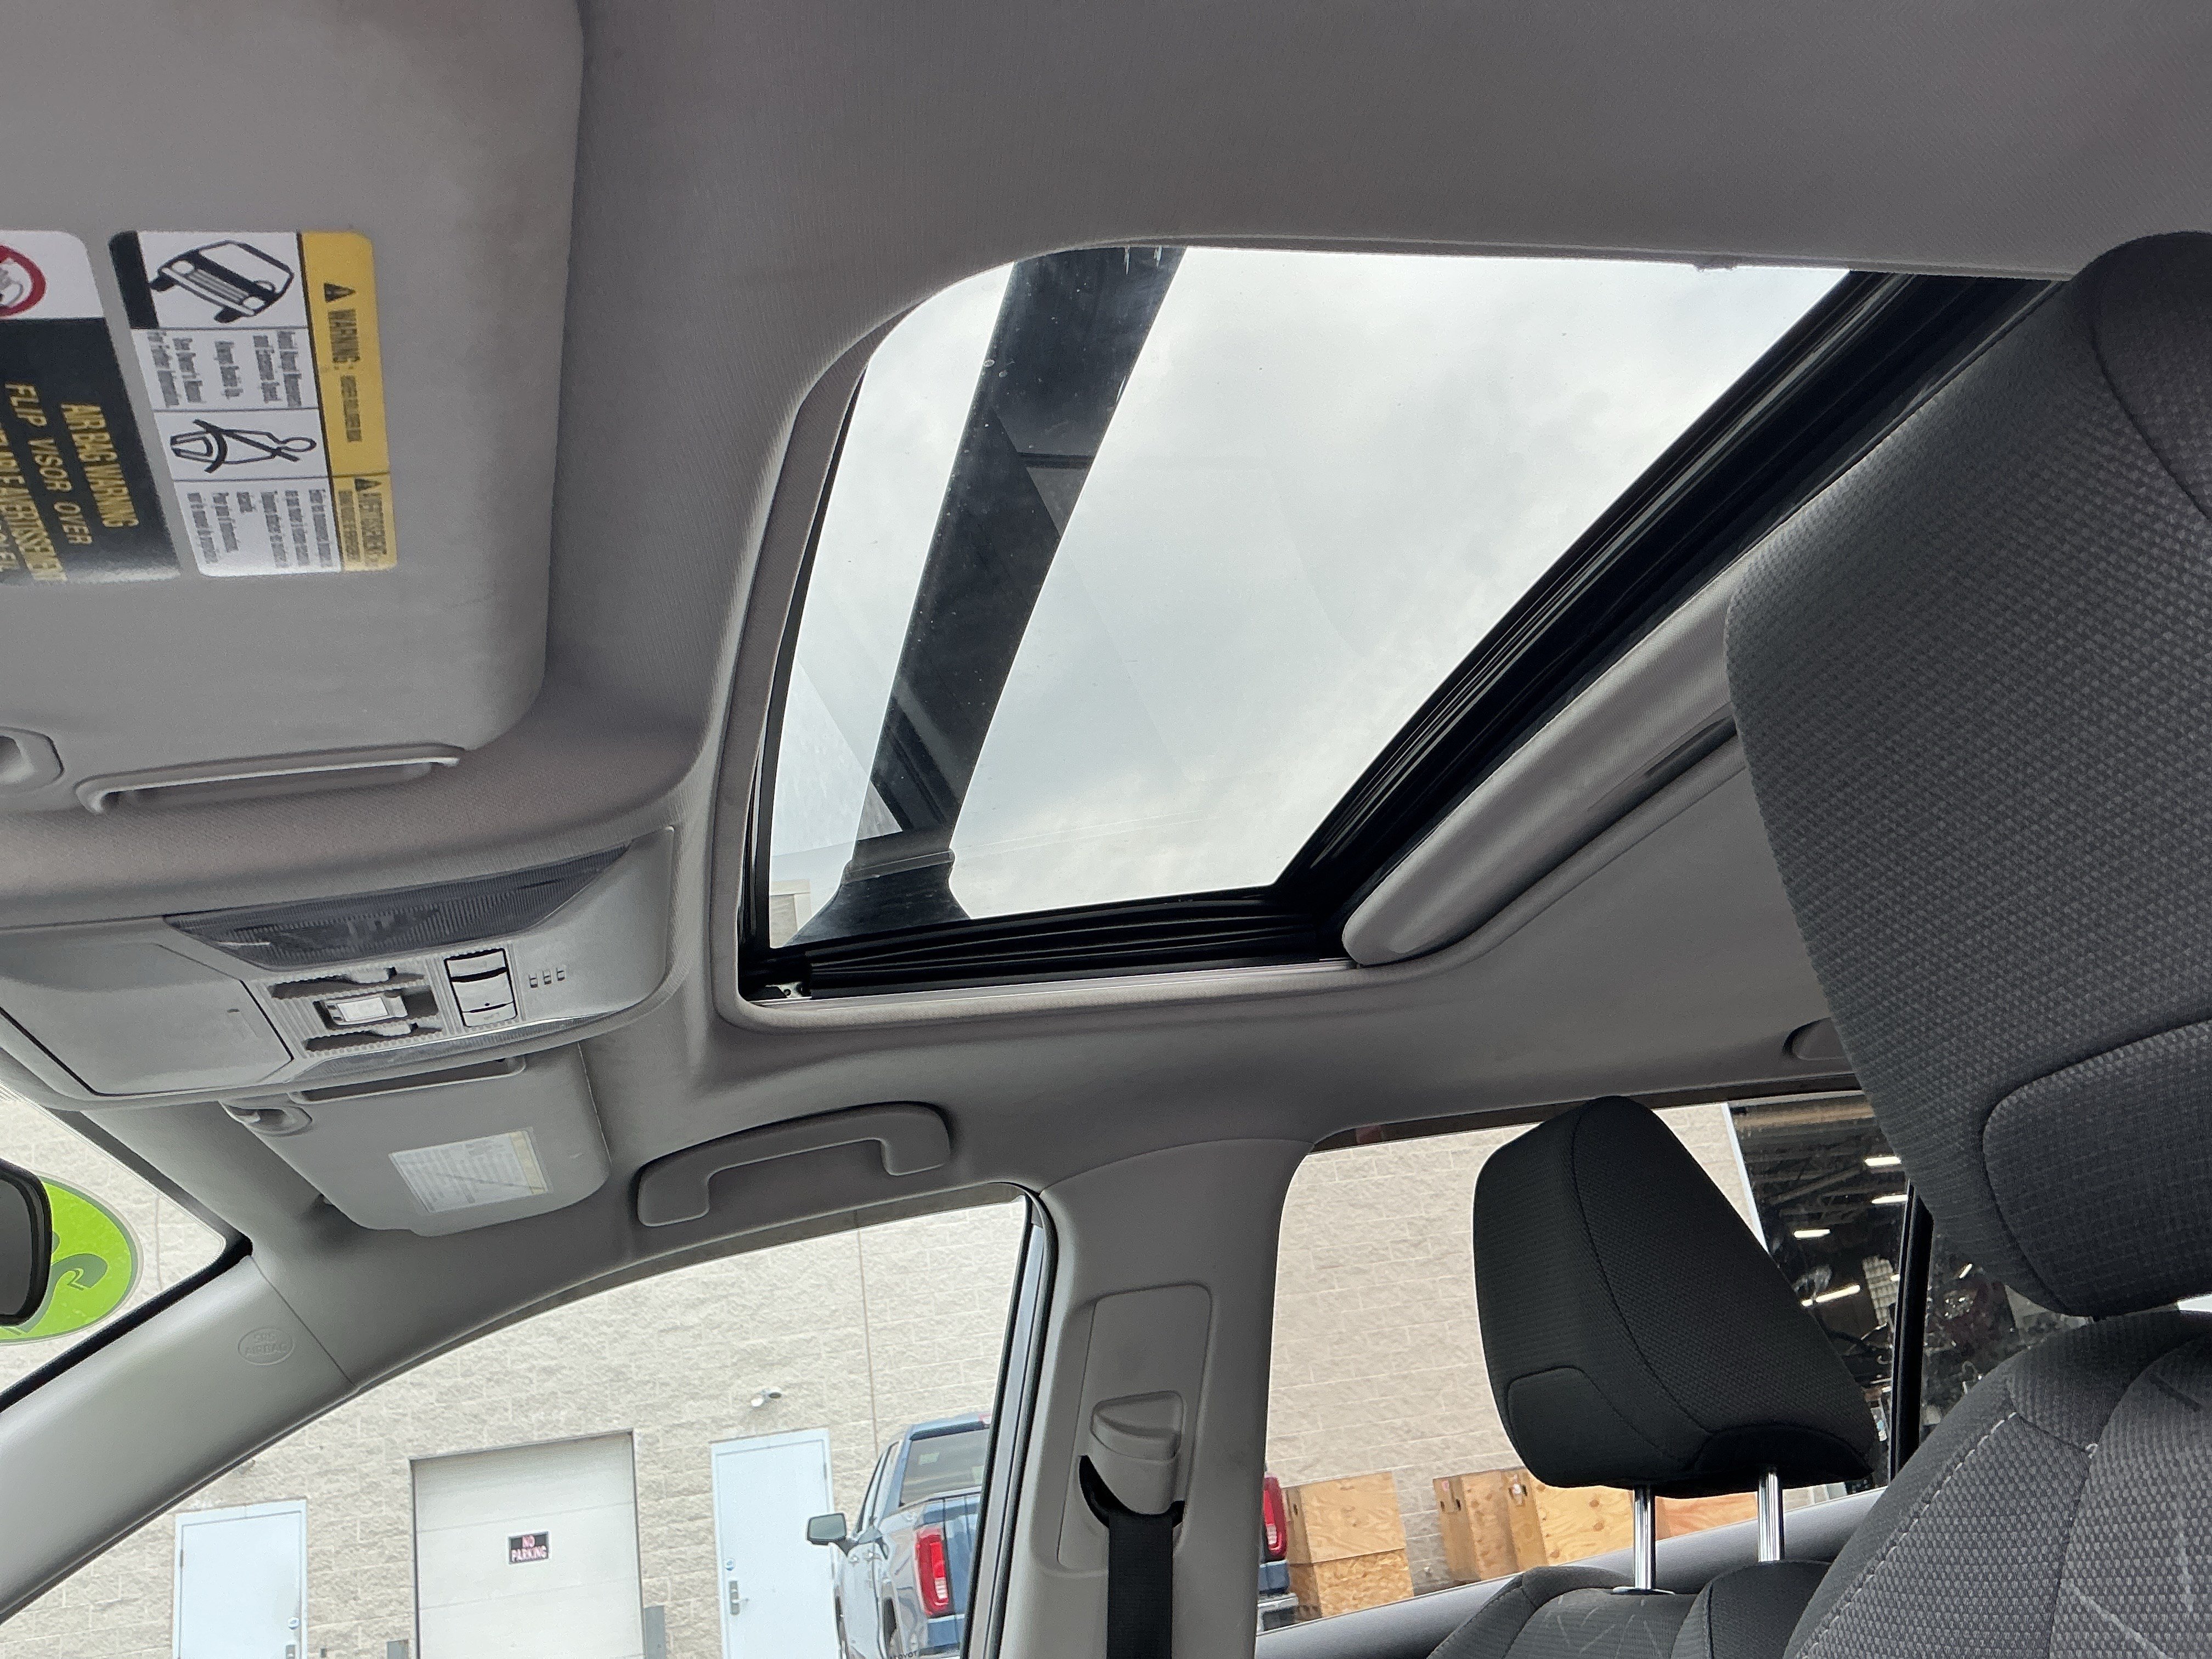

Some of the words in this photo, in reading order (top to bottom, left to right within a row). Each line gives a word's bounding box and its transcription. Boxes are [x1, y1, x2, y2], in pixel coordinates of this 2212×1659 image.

[61, 404, 106, 430] AIR
[72, 432, 117, 462] BAG
[4, 383, 47, 426] FLIP
[28, 439, 72, 492] VISOR
[54, 501, 93, 544] OVER
[84, 464, 140, 527] WARNING
[511, 1545, 547, 1562] PARKING
[522, 1534, 535, 1548] NO
